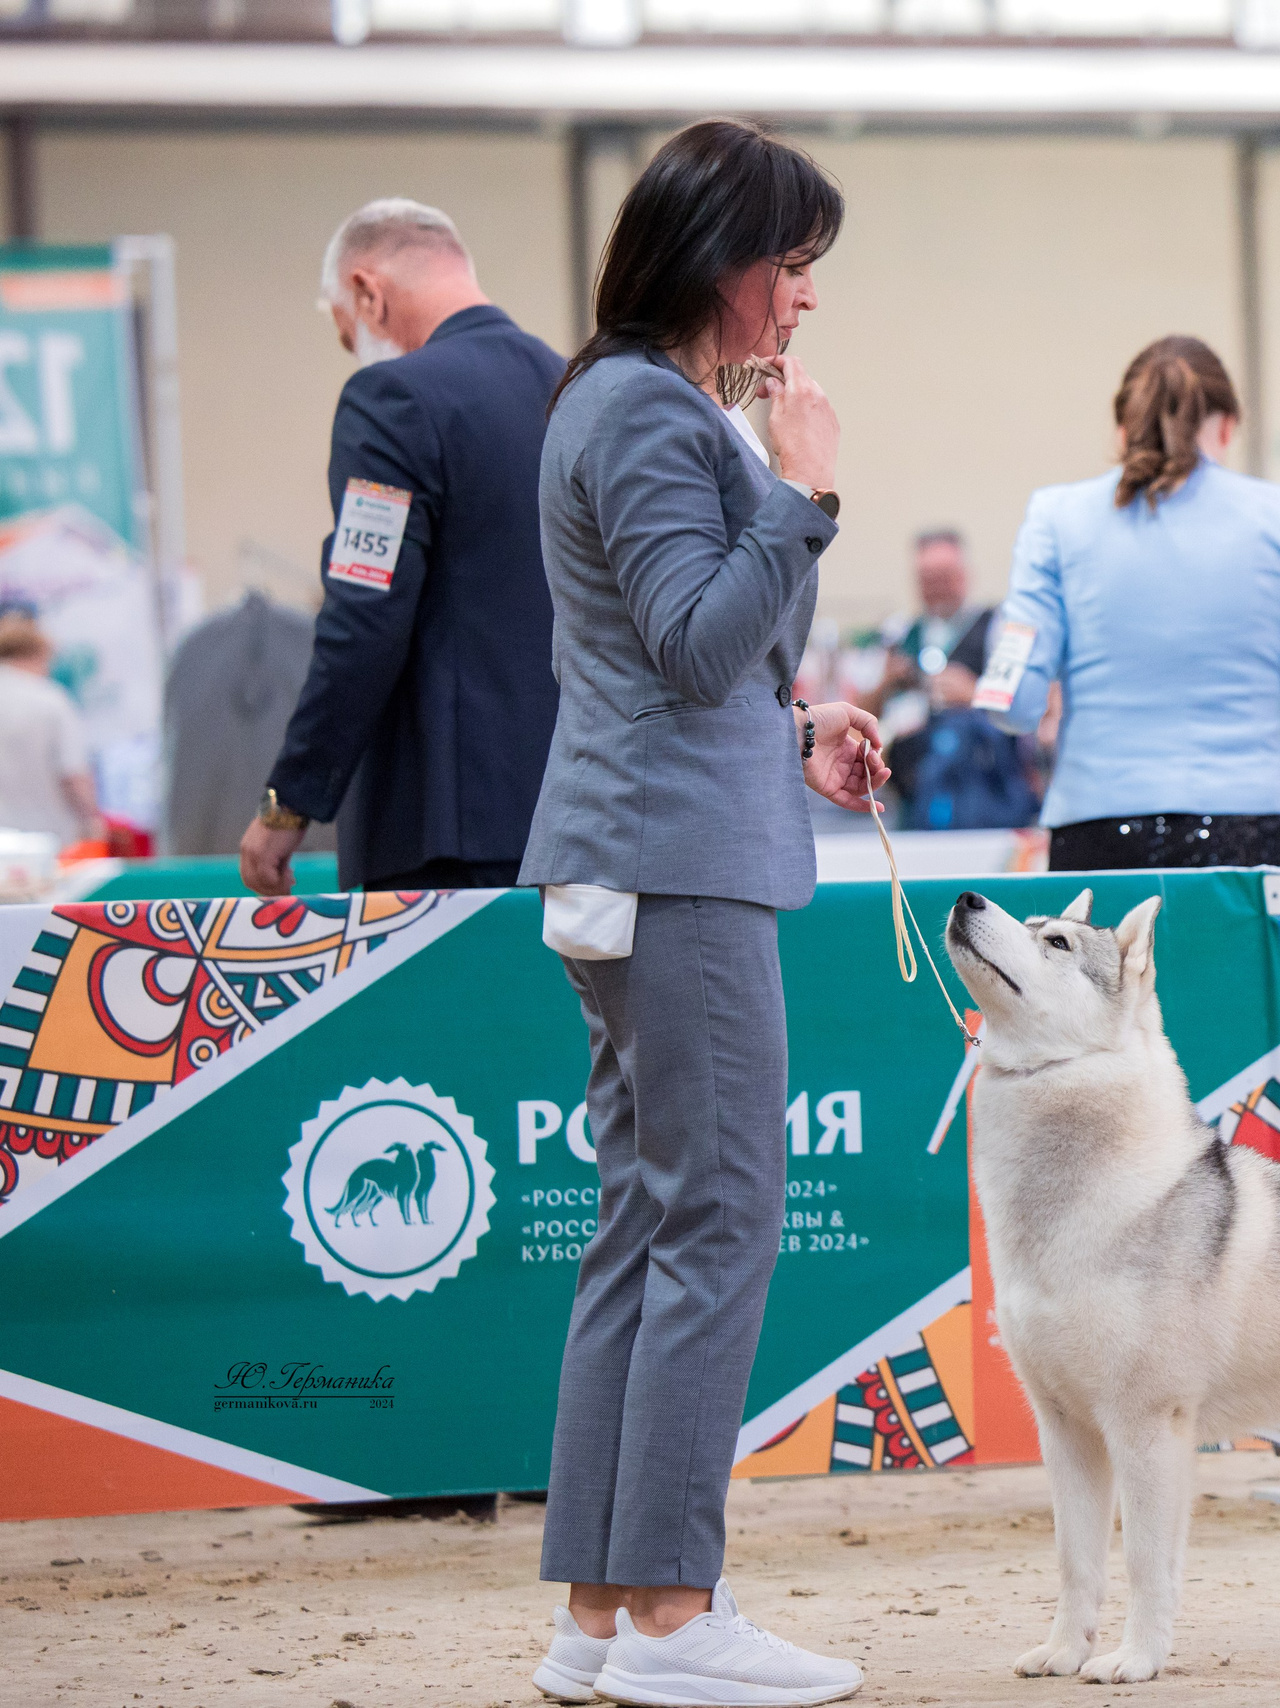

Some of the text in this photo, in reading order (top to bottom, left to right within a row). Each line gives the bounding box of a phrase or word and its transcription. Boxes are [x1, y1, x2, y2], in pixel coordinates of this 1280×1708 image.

[343, 527, 389, 557] 1455
[521, 1179, 838, 1208] «РОСС 024»
[521, 1218, 597, 1239] «РОСС
[829, 1209, 845, 1228] &
[521, 1242, 584, 1263] КУБО
[808, 1232, 870, 1252] 2024»
